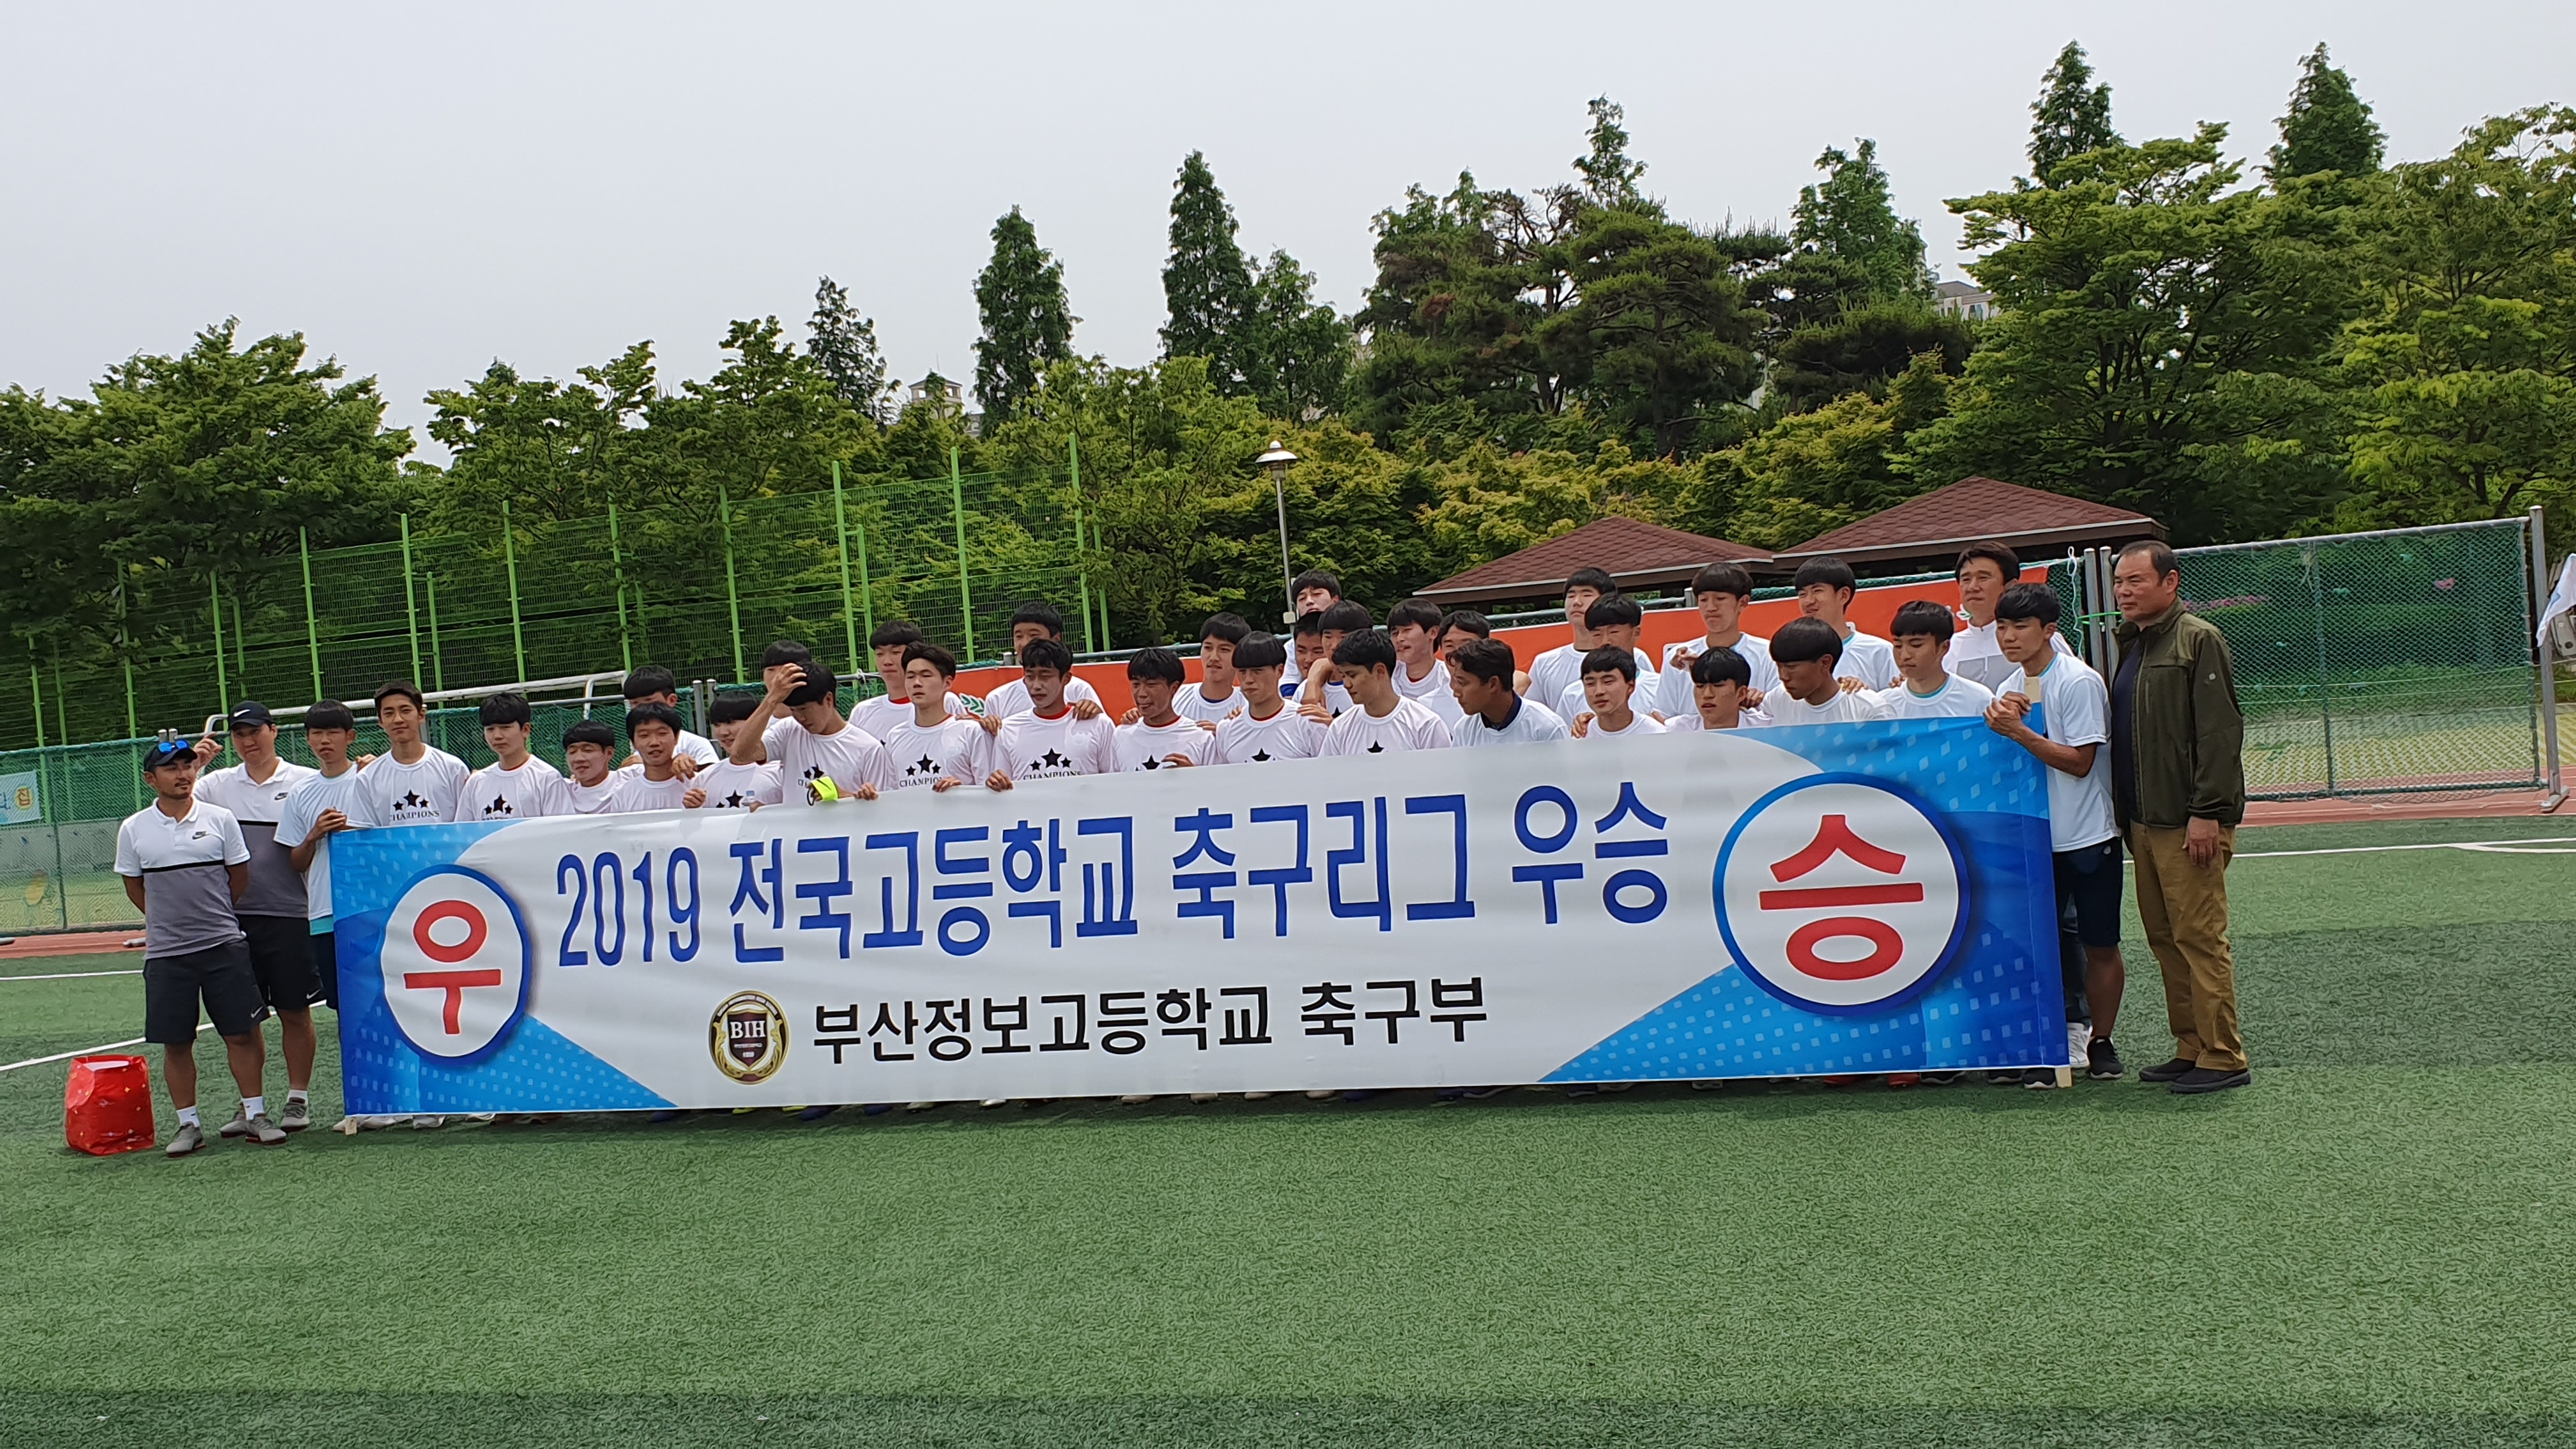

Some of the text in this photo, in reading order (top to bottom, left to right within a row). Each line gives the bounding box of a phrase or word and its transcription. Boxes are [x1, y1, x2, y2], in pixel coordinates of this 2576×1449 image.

[557, 782, 1669, 967] 2019 전국고등학교 축구리그 우승
[1759, 815, 1924, 981] 승
[404, 900, 502, 1035] 우
[730, 1021, 766, 1039] BIH
[814, 977, 1487, 1064] 부산정보고등학교 축구부
